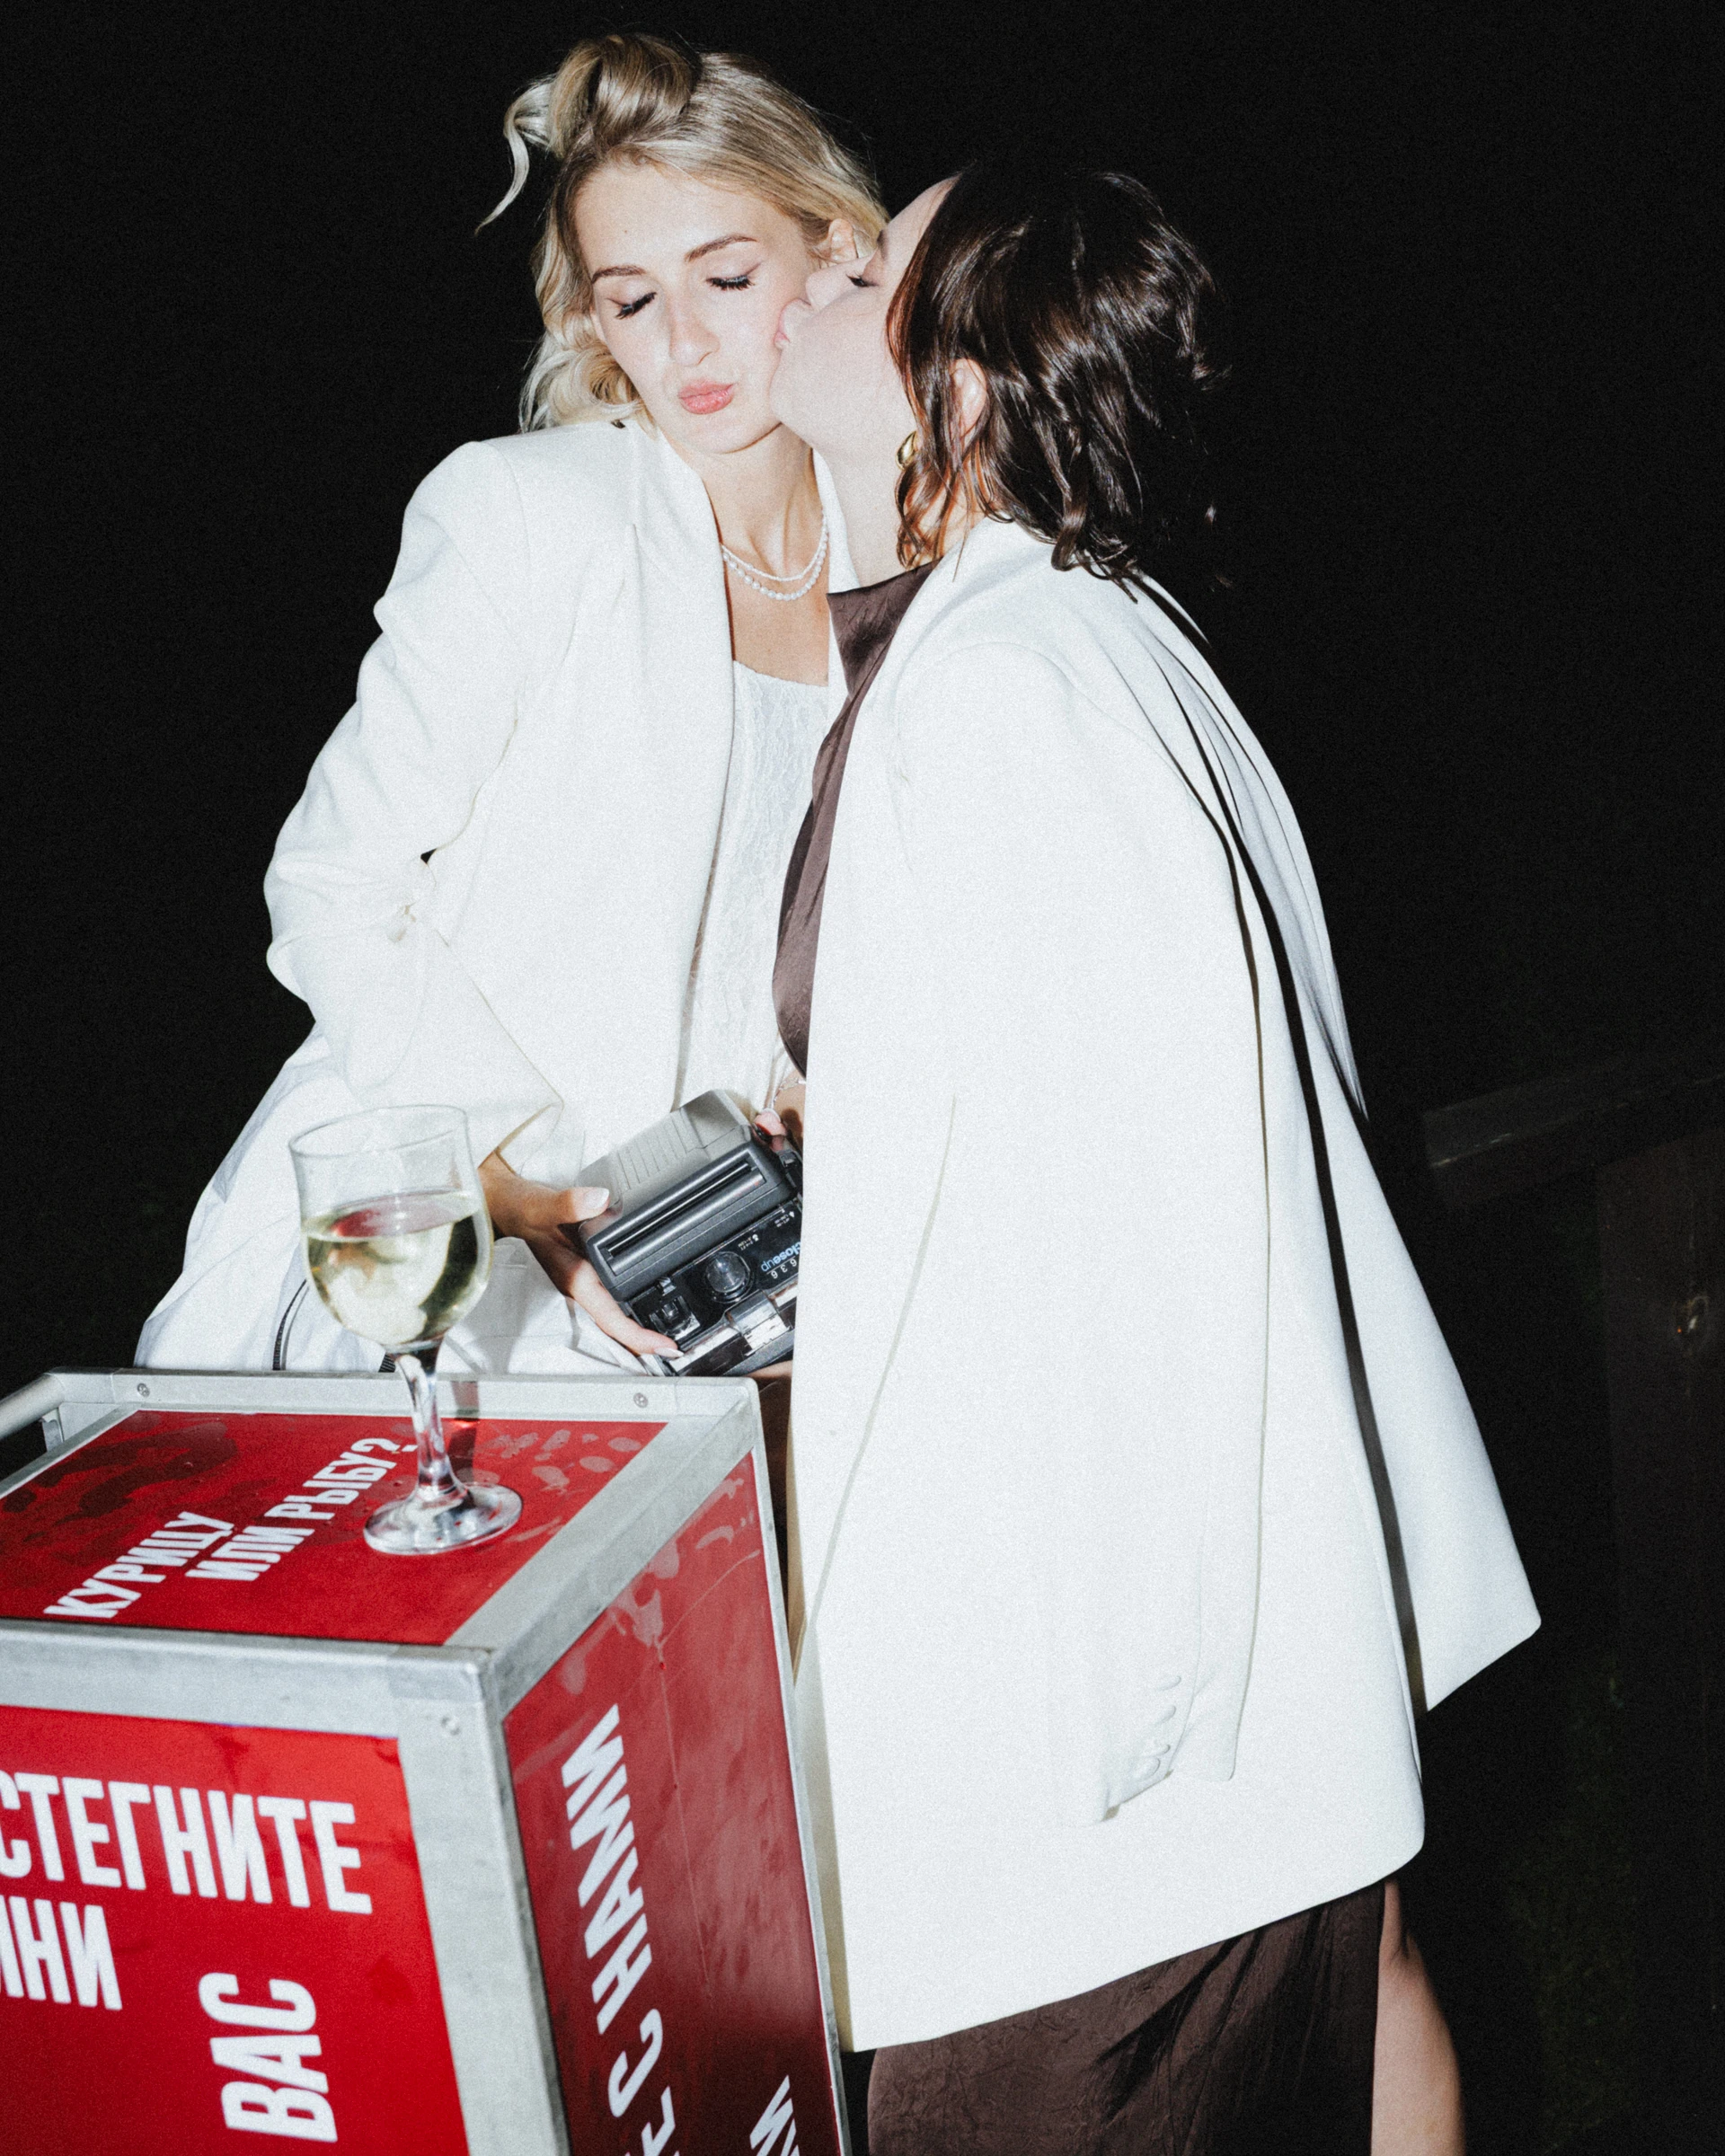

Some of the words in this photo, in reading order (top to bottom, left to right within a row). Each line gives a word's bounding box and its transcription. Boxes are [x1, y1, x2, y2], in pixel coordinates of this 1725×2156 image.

[761, 1241, 801, 1272] closeup
[43, 1511, 235, 1619] КУРИЦУ
[185, 1525, 314, 1582] ИЛИ
[263, 1436, 418, 1521] РЫБУ?
[561, 1703, 652, 2036] НАМИ
[199, 1972, 338, 2143] ВАС
[607, 2008, 663, 2118] С
